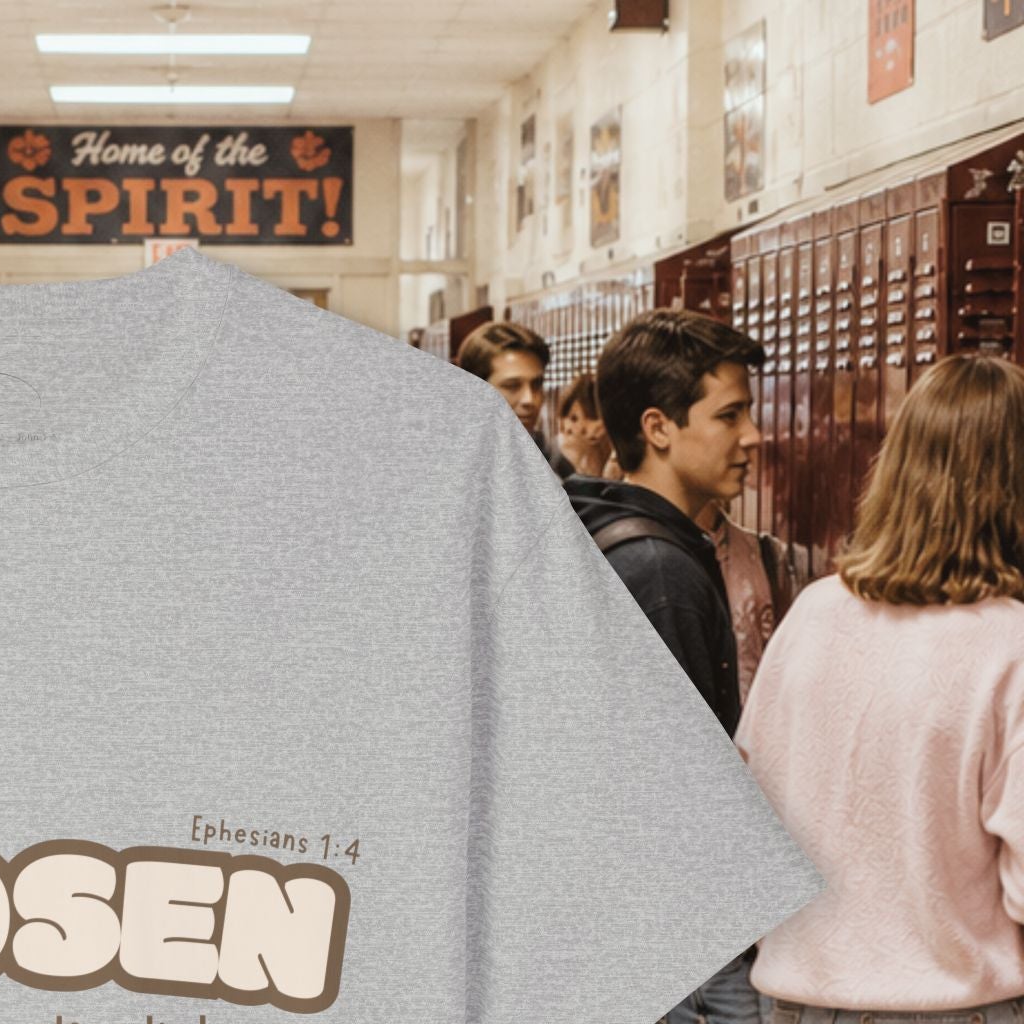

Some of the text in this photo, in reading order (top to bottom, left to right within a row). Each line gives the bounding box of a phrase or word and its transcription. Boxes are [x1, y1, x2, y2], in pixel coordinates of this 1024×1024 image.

[71, 130, 269, 176] Home of the
[1, 176, 344, 238] SPIRIT!
[191, 815, 360, 864] Ephesians 1:4
